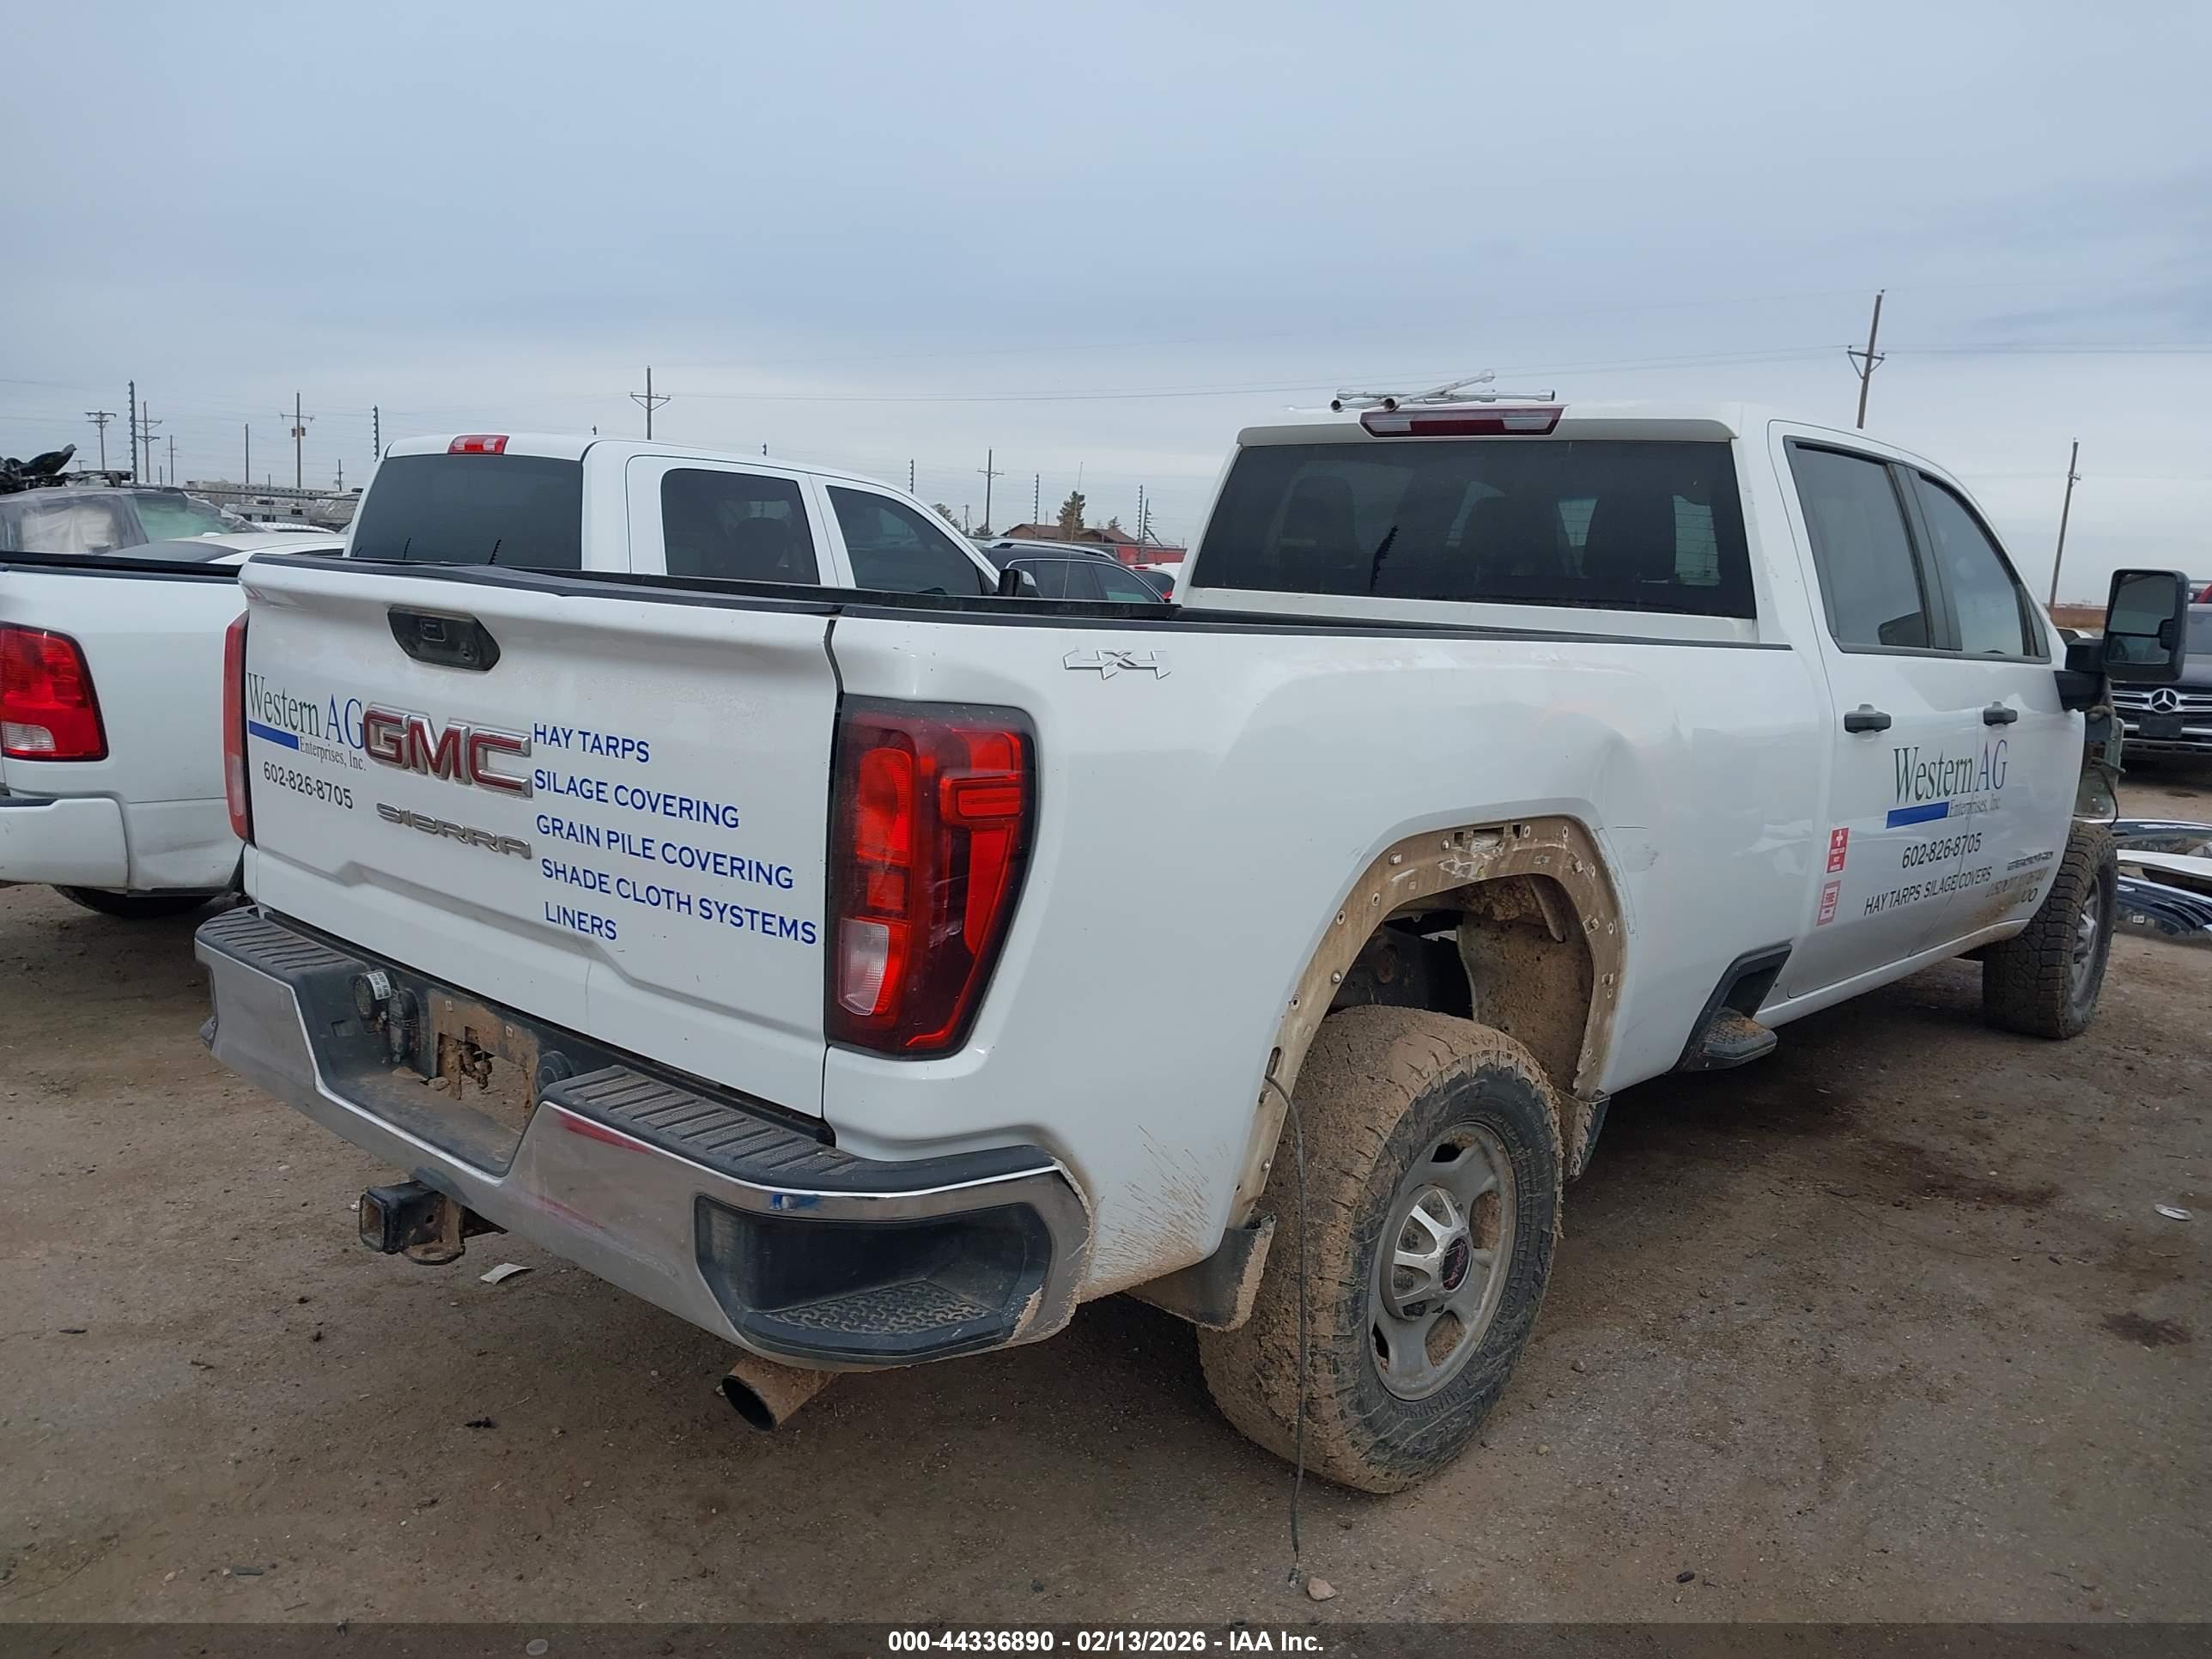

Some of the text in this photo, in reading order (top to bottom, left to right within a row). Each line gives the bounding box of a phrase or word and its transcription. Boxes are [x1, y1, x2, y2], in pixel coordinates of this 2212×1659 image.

[247, 672, 364, 750] Western AG
[300, 735, 367, 771] Enterprises, Inc.
[362, 702, 533, 799] GMC
[533, 722, 650, 763] HAY TARPS
[1893, 738, 2008, 805] Western AG
[263, 761, 354, 810] 602-826-8705
[534, 769, 739, 829] SILAGE COVERING
[376, 802, 532, 860] SIERRA
[536, 814, 794, 890] GRAIN PILE COVERING
[1902, 832, 1982, 869] 602-826-8705
[541, 858, 817, 945] SHADE CLOTH SYSTEMS
[1863, 892, 1889, 916] HAY
[1889, 884, 1922, 908] TARPS
[1923, 874, 1959, 899] SILAGE
[1959, 866, 1992, 889] COVERS
[544, 901, 617, 940] LINERS
